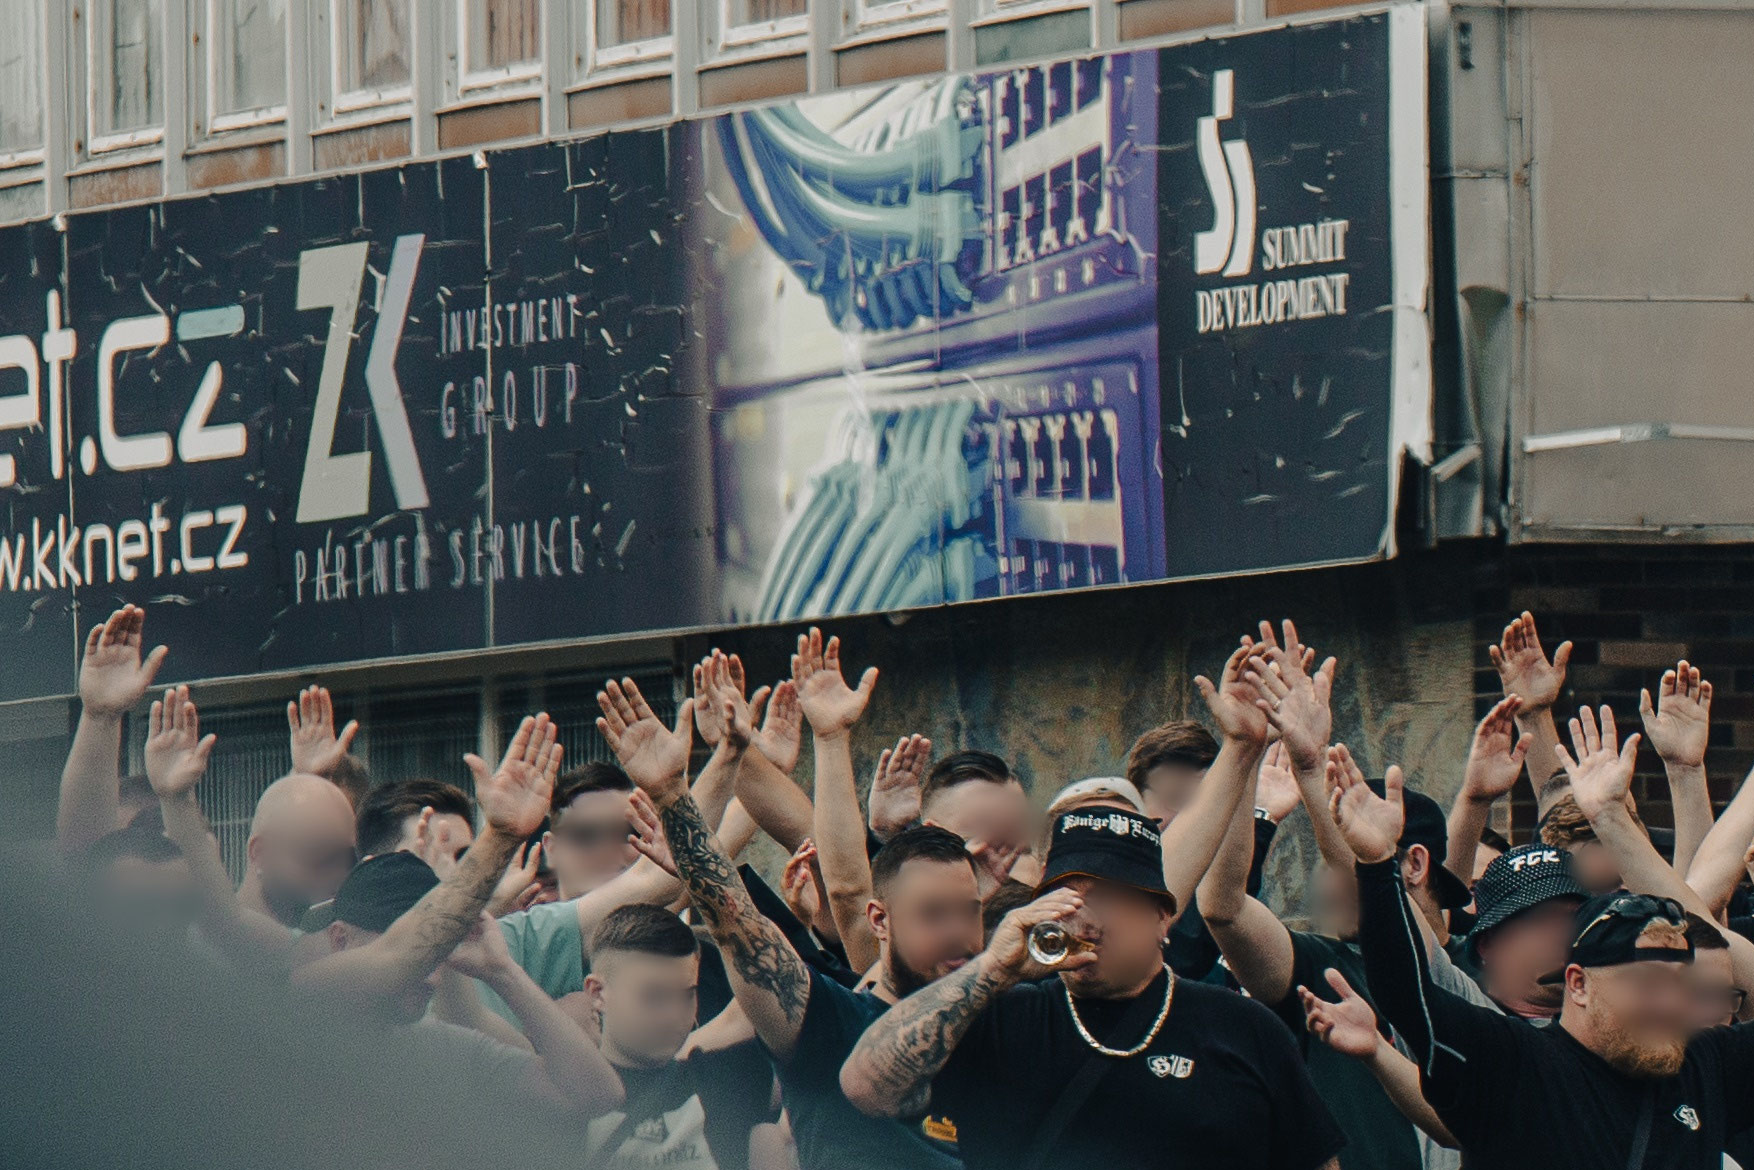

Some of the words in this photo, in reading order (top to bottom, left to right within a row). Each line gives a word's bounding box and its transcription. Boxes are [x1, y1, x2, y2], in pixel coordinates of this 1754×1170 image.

[1262, 219, 1349, 271] SUMMIT
[440, 293, 578, 354] INVESTMENT
[1195, 273, 1350, 333] DEVELOPMENT
[441, 362, 577, 439] GROUP
[295, 530, 429, 604] PARTNER
[450, 514, 585, 588] SERVICE
